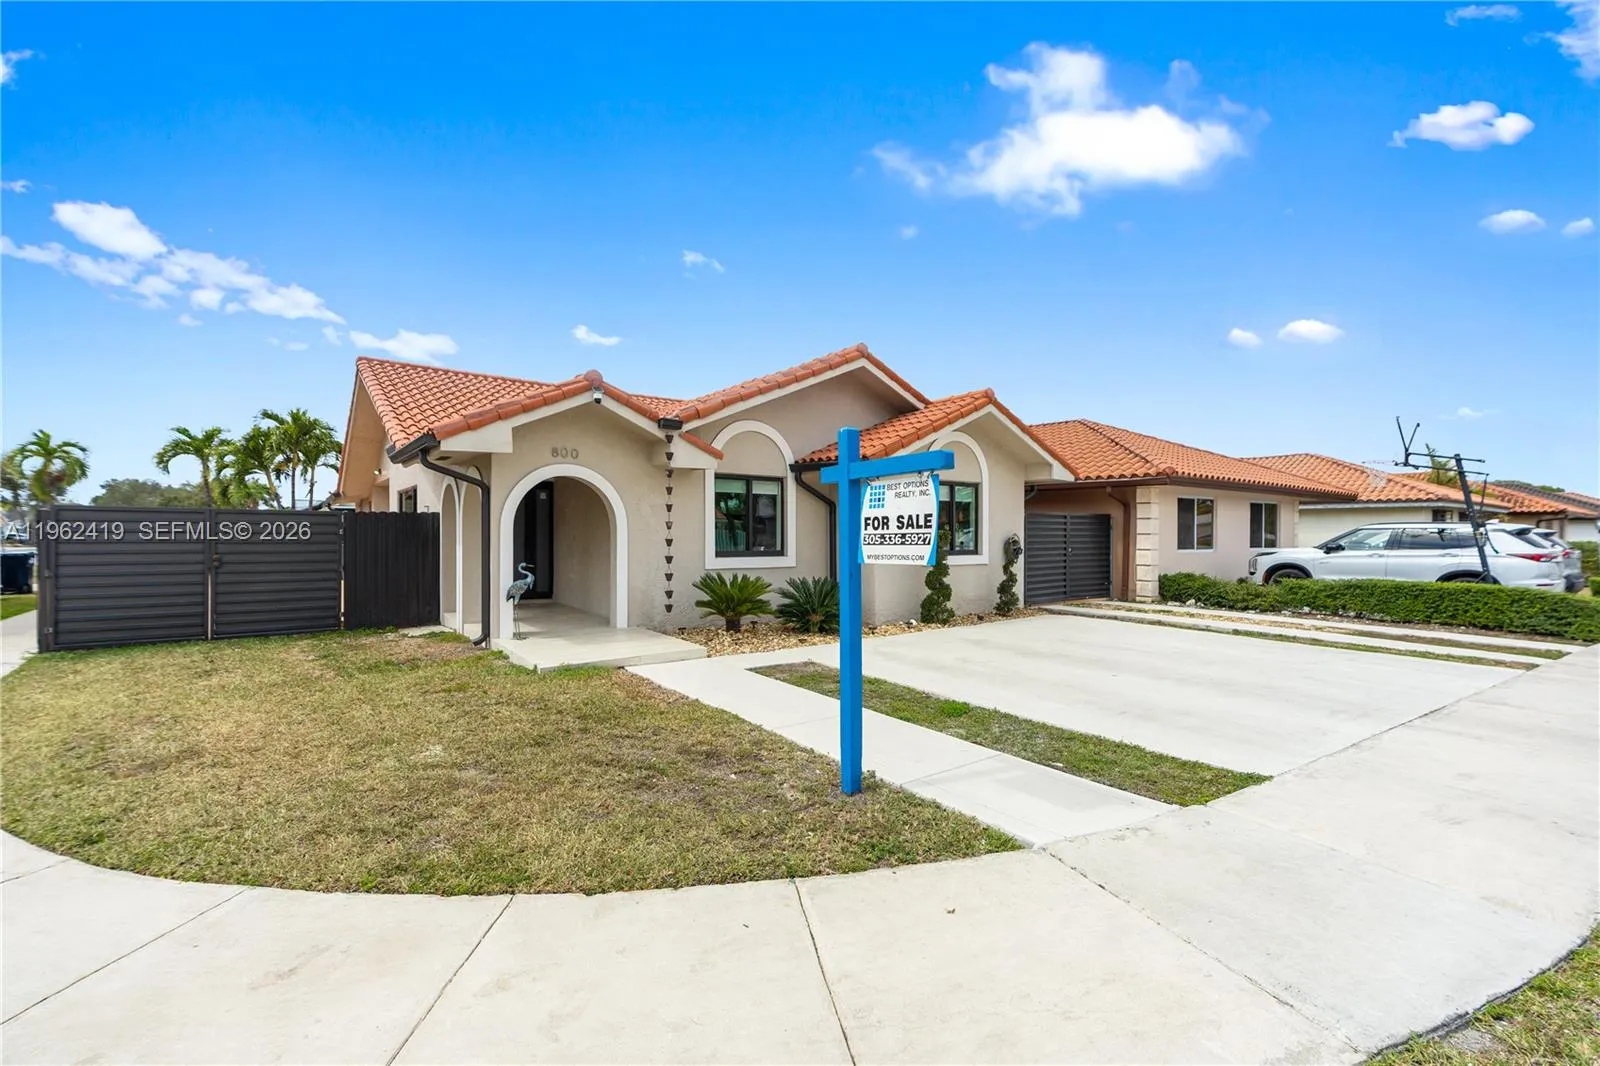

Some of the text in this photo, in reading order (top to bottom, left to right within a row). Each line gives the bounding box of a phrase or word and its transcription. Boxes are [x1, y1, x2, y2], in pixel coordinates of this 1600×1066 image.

[551, 446, 579, 460] 800
[886, 479, 929, 491] BEST OPTIONS
[894, 489, 930, 499] REALTY, INC.
[864, 513, 933, 531] FOR SALE
[863, 533, 931, 545] 305-336-5927
[866, 553, 925, 562] MYBESTOPTIONS.COM
